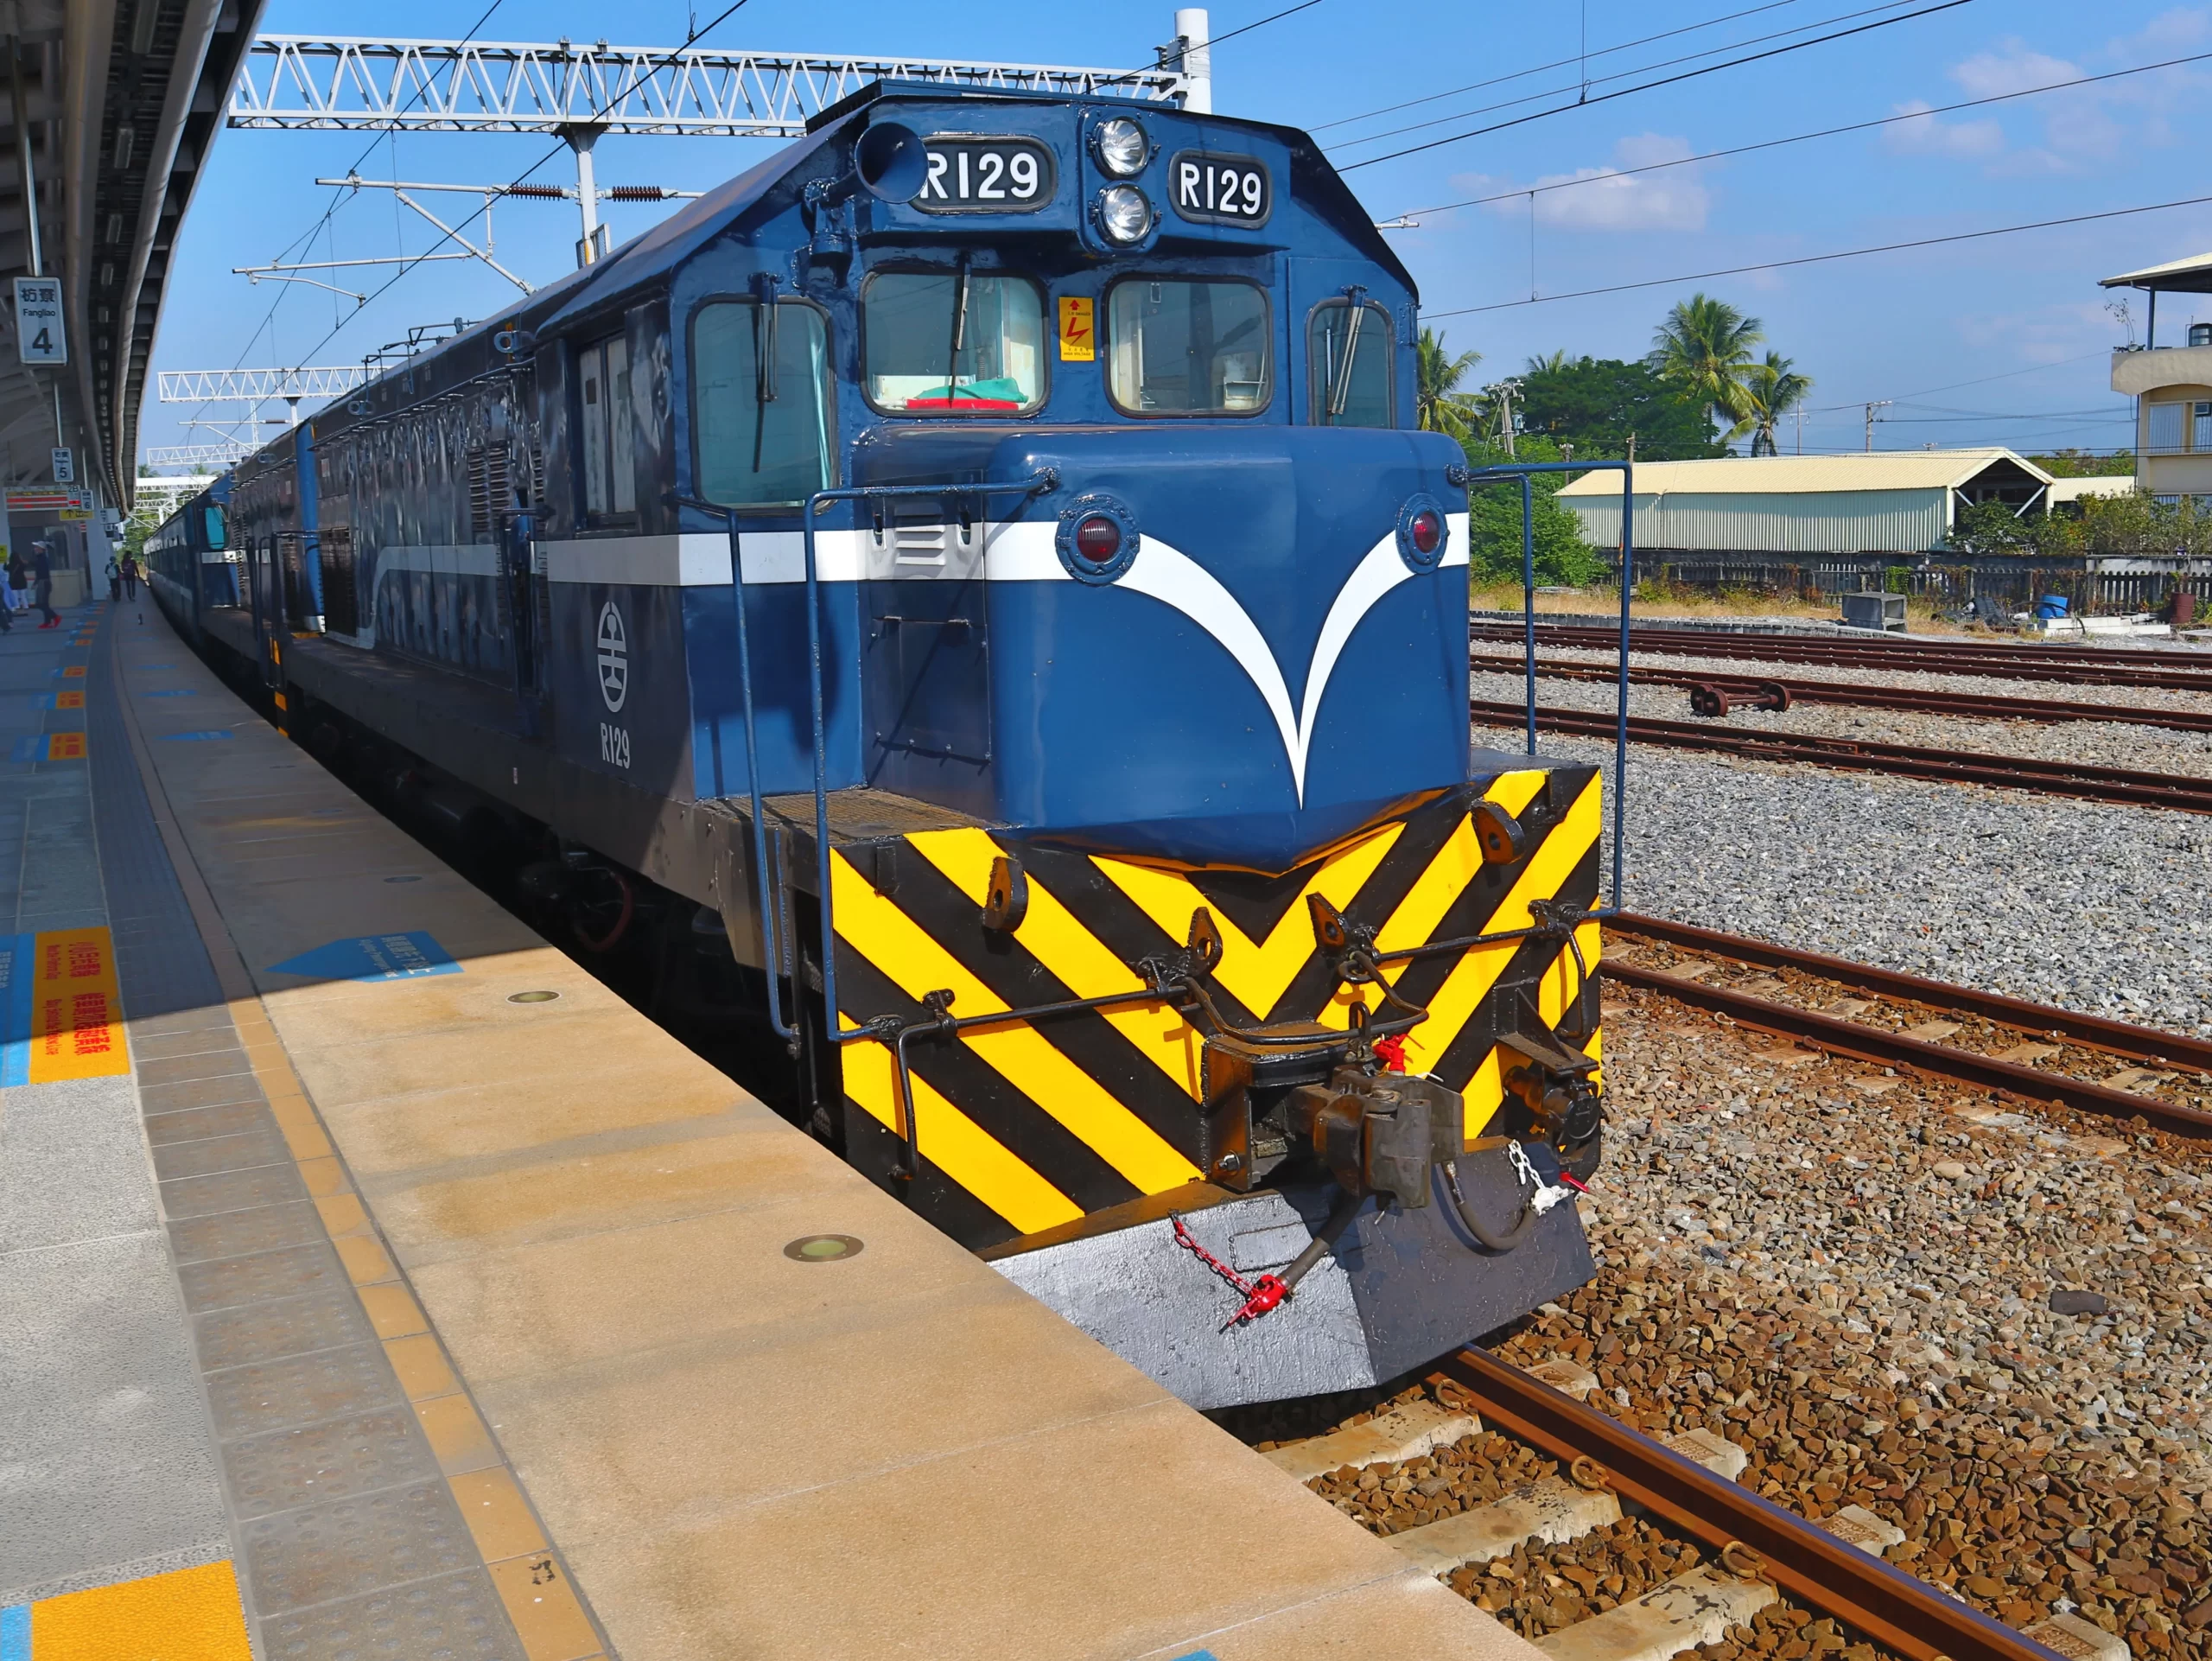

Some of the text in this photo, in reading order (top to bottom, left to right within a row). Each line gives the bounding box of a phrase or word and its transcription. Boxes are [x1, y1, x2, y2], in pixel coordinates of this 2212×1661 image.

[1180, 162, 1262, 214] R129
[22, 309, 56, 318] Fangliao
[32, 328, 53, 354] 4
[60, 467, 67, 478] 5
[601, 722, 631, 769] R129
